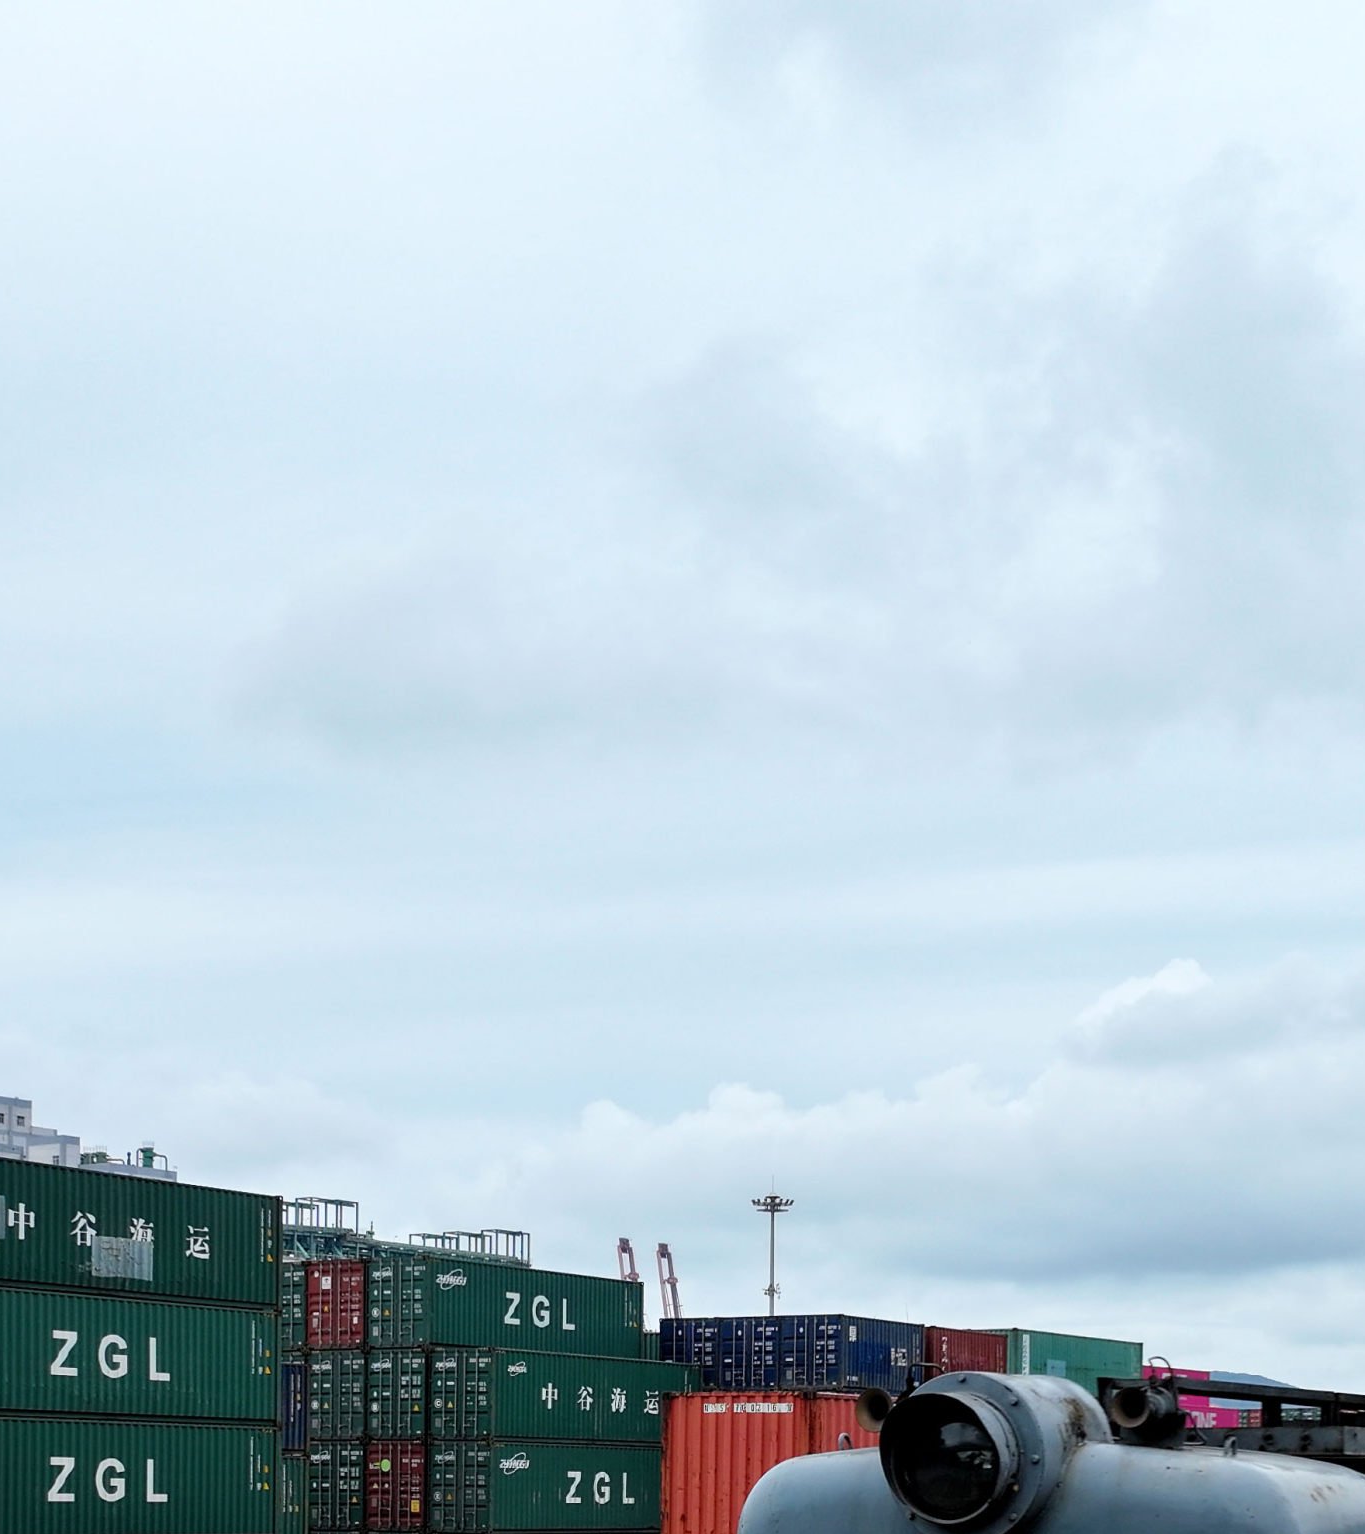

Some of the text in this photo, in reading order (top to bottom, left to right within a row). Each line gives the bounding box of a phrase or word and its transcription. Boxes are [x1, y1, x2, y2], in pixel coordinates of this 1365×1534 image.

[8, 1203, 210, 1260] 中谷海运
[504, 1292, 576, 1331] ZGL
[50, 1330, 171, 1382] ZGL
[542, 1382, 659, 1415] 中谷海运
[47, 1457, 168, 1502] ZGL
[566, 1471, 635, 1504] ZGL
